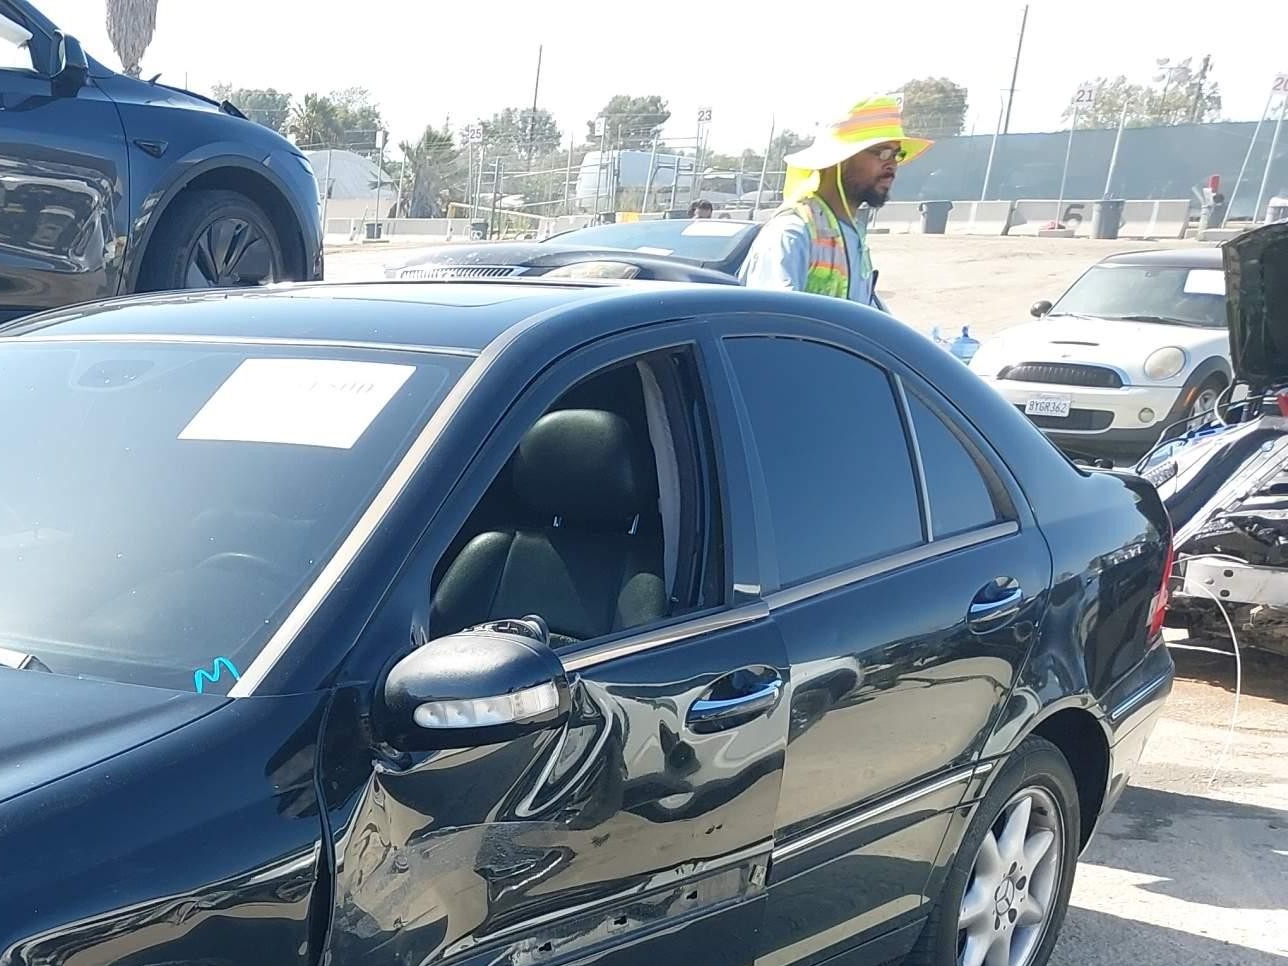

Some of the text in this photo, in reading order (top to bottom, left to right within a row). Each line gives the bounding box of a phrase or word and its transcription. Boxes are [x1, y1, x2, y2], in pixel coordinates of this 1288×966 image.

[1077, 90, 1092, 102] 21
[698, 110, 712, 121] 23
[470, 128, 482, 139] 25
[194, 656, 240, 694] M
